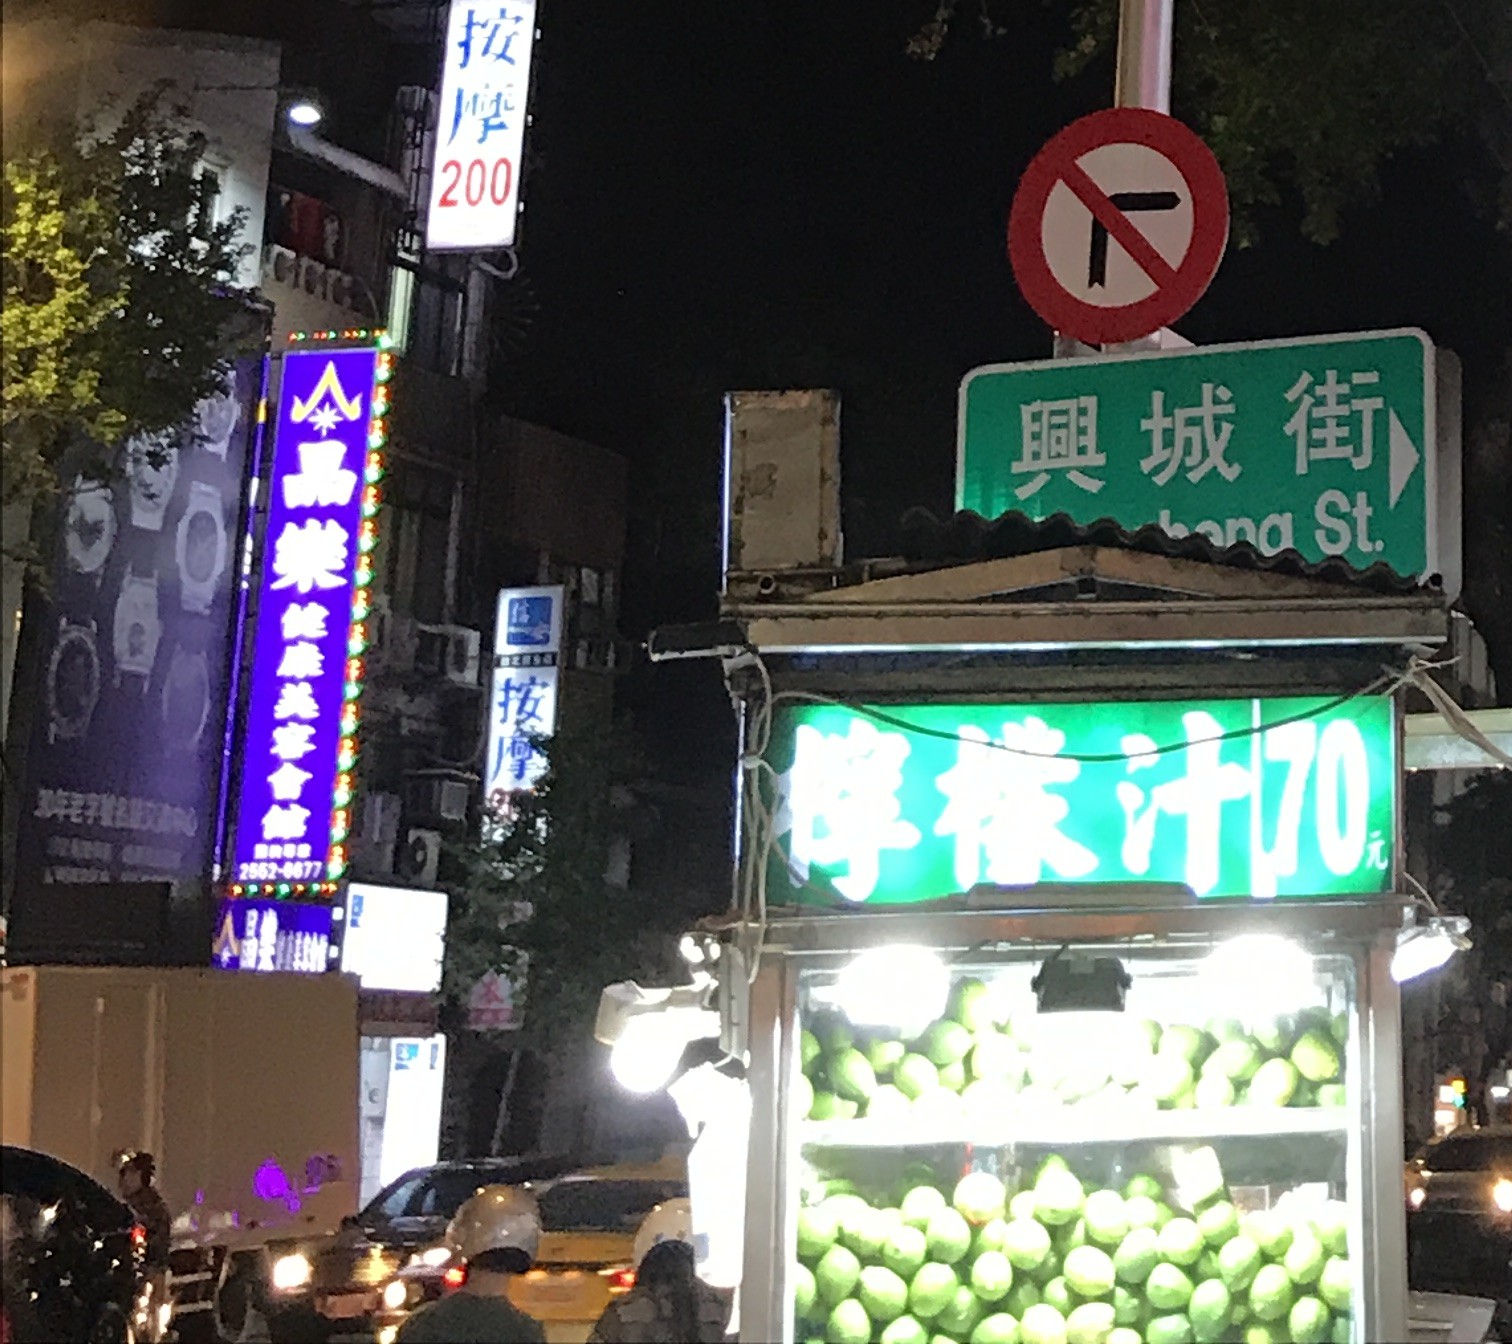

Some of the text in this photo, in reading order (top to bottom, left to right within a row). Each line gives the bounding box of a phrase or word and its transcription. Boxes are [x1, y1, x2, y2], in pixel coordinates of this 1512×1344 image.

[447, 7, 524, 148] 按摩
[438, 157, 512, 208] 200
[1010, 369, 1385, 501] 興城街
[1314, 488, 1385, 555] St.
[786, 712, 1253, 904] 檸檬汁
